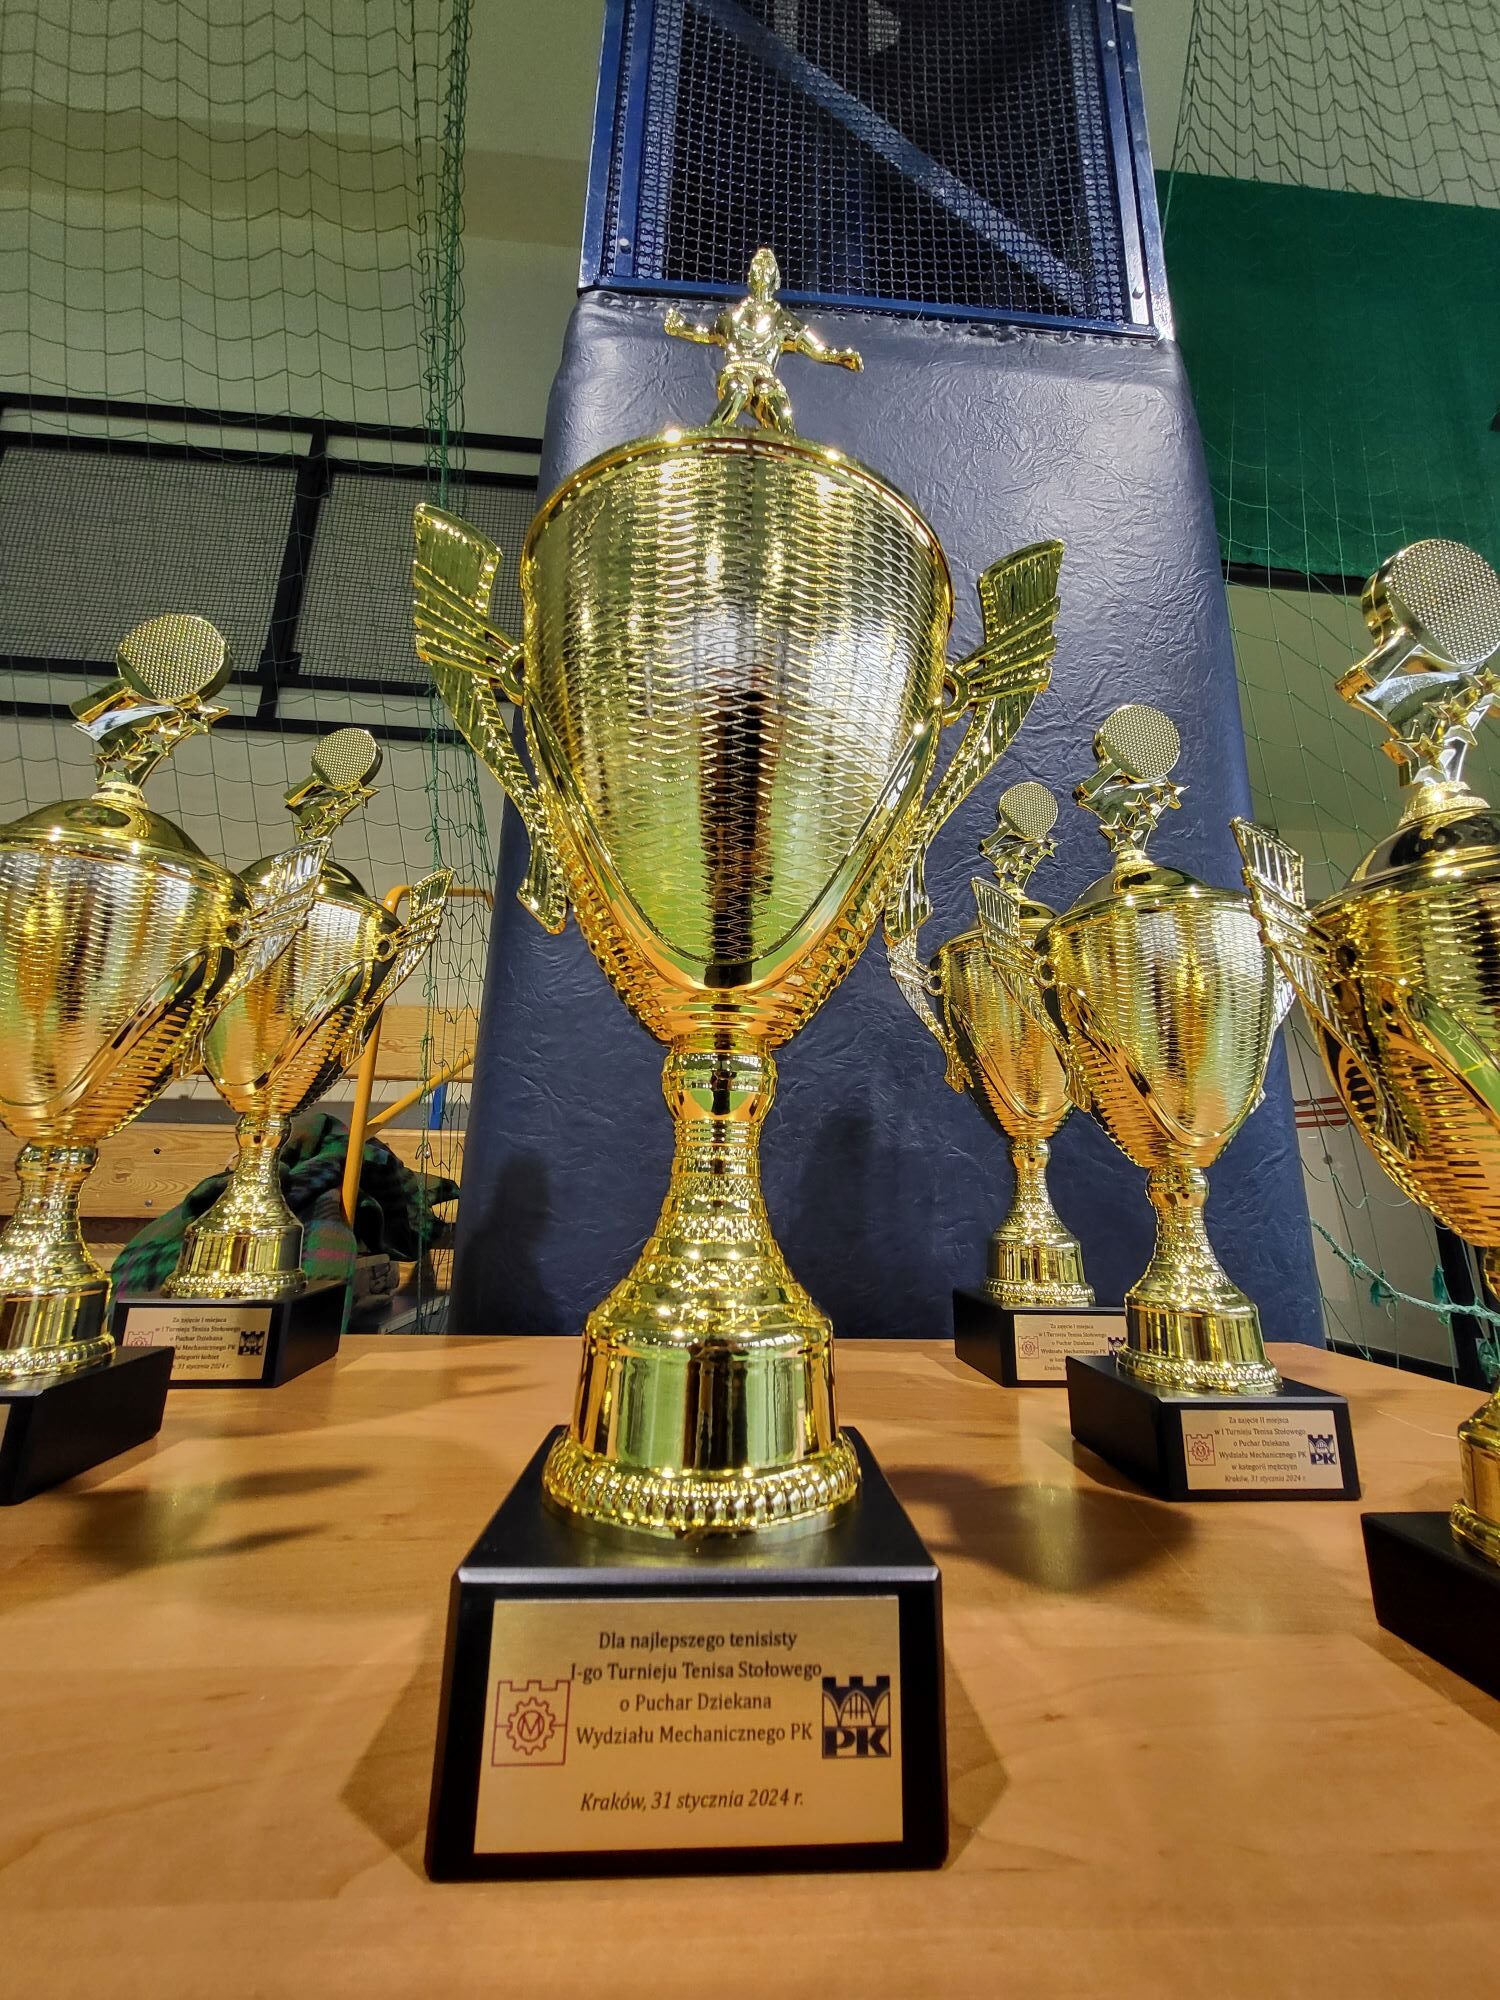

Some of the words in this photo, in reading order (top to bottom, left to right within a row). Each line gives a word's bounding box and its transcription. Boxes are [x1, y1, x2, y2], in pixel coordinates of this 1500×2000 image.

[1250, 1451, 1296, 1459] Mechanicznego
[599, 1631, 627, 1650] Dla
[630, 1631, 724, 1653] najlepszego
[729, 1629, 797, 1650] tenisisty
[607, 1662, 677, 1682] Turnieju
[683, 1662, 734, 1680] Tenisa
[738, 1660, 822, 1681] Stołowego
[620, 1698, 630, 1711] o
[635, 1693, 692, 1711] Puchar
[698, 1693, 772, 1711] Dziekana
[576, 1725, 653, 1748] Wydziału
[659, 1724, 786, 1744] Mechanicznego
[791, 1722, 812, 1741] PK
[823, 1726, 890, 1758] PK
[580, 1793, 647, 1812] Kraków,
[651, 1793, 671, 1810] 31
[677, 1789, 743, 1814] stycznia
[748, 1789, 789, 1807] 2024
[794, 1792, 803, 1806] r.
